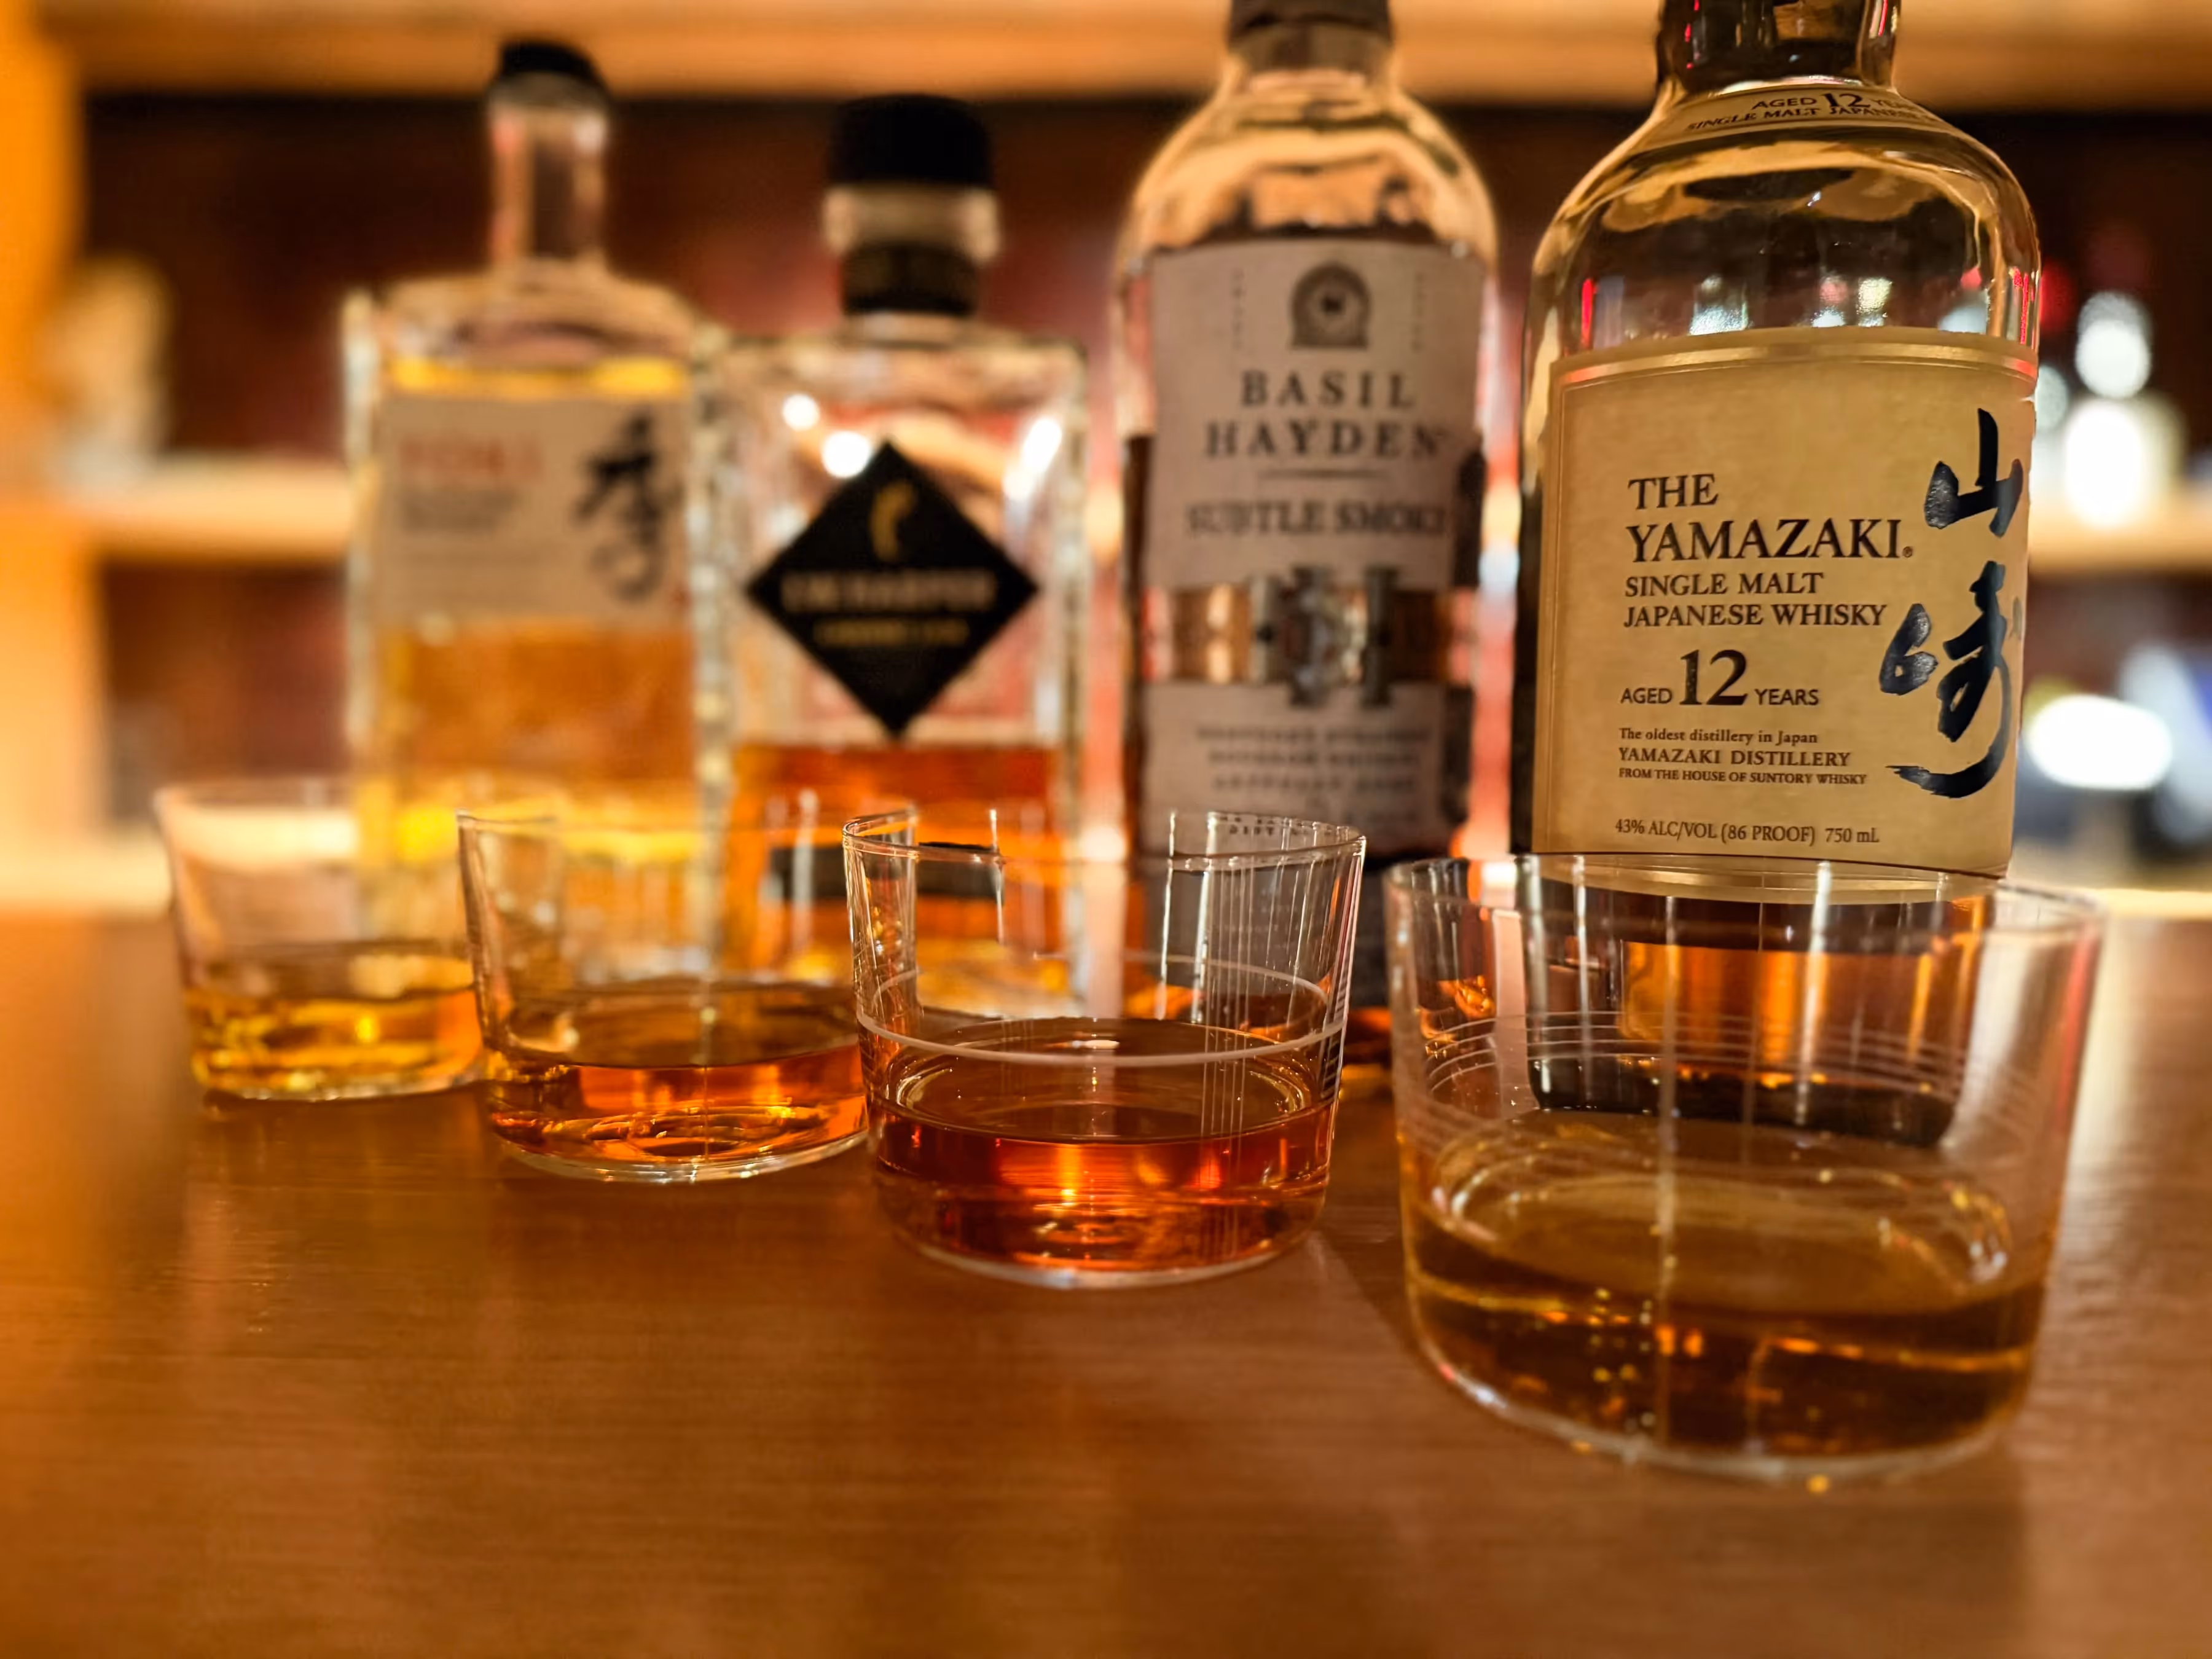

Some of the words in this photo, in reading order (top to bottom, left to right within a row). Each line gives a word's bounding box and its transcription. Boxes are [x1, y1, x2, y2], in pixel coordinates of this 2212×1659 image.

[1751, 97, 1817, 111] AGED
[1821, 92, 1870, 108] 12
[1687, 113, 1757, 131] SINGLE
[1763, 108, 1821, 119] MALT
[1241, 370, 1413, 409] BASIL
[1204, 420, 1442, 458] HAYDEN
[1628, 473, 1719, 510] THE
[1626, 518, 1902, 563] YAMAZAKI
[1625, 573, 1728, 597] SINGLE
[1738, 572, 1824, 595] MALT
[1623, 605, 1764, 628] JAPANESE
[1770, 605, 1888, 626] WHISKY
[1620, 688, 1673, 704] AGED
[1679, 649, 1748, 706] 12
[1754, 689, 1819, 706] YEARS
[1619, 728, 1641, 740] The
[1645, 728, 1685, 742] oldest
[1689, 729, 1754, 745] distillery
[1758, 731, 1773, 743] in
[1775, 731, 1818, 747] Japan
[1619, 747, 1720, 764] YAMAZAKI
[1730, 750, 1851, 767] DISTILLERY
[1619, 768, 1651, 779] FROM
[1655, 769, 1679, 780] THE
[1682, 771, 1725, 782] HOUSE
[1729, 772, 1746, 783] OF
[1749, 772, 1813, 783] SUNTORY
[1816, 774, 1867, 785] WHISKY
[1615, 819, 1645, 834] 43%
[1648, 821, 1717, 841] ALC/VOL
[1720, 823, 1746, 844] (86
[1752, 825, 1816, 847] PROOF)
[1825, 828, 1851, 842] 750
[1856, 828, 1880, 843] mL
